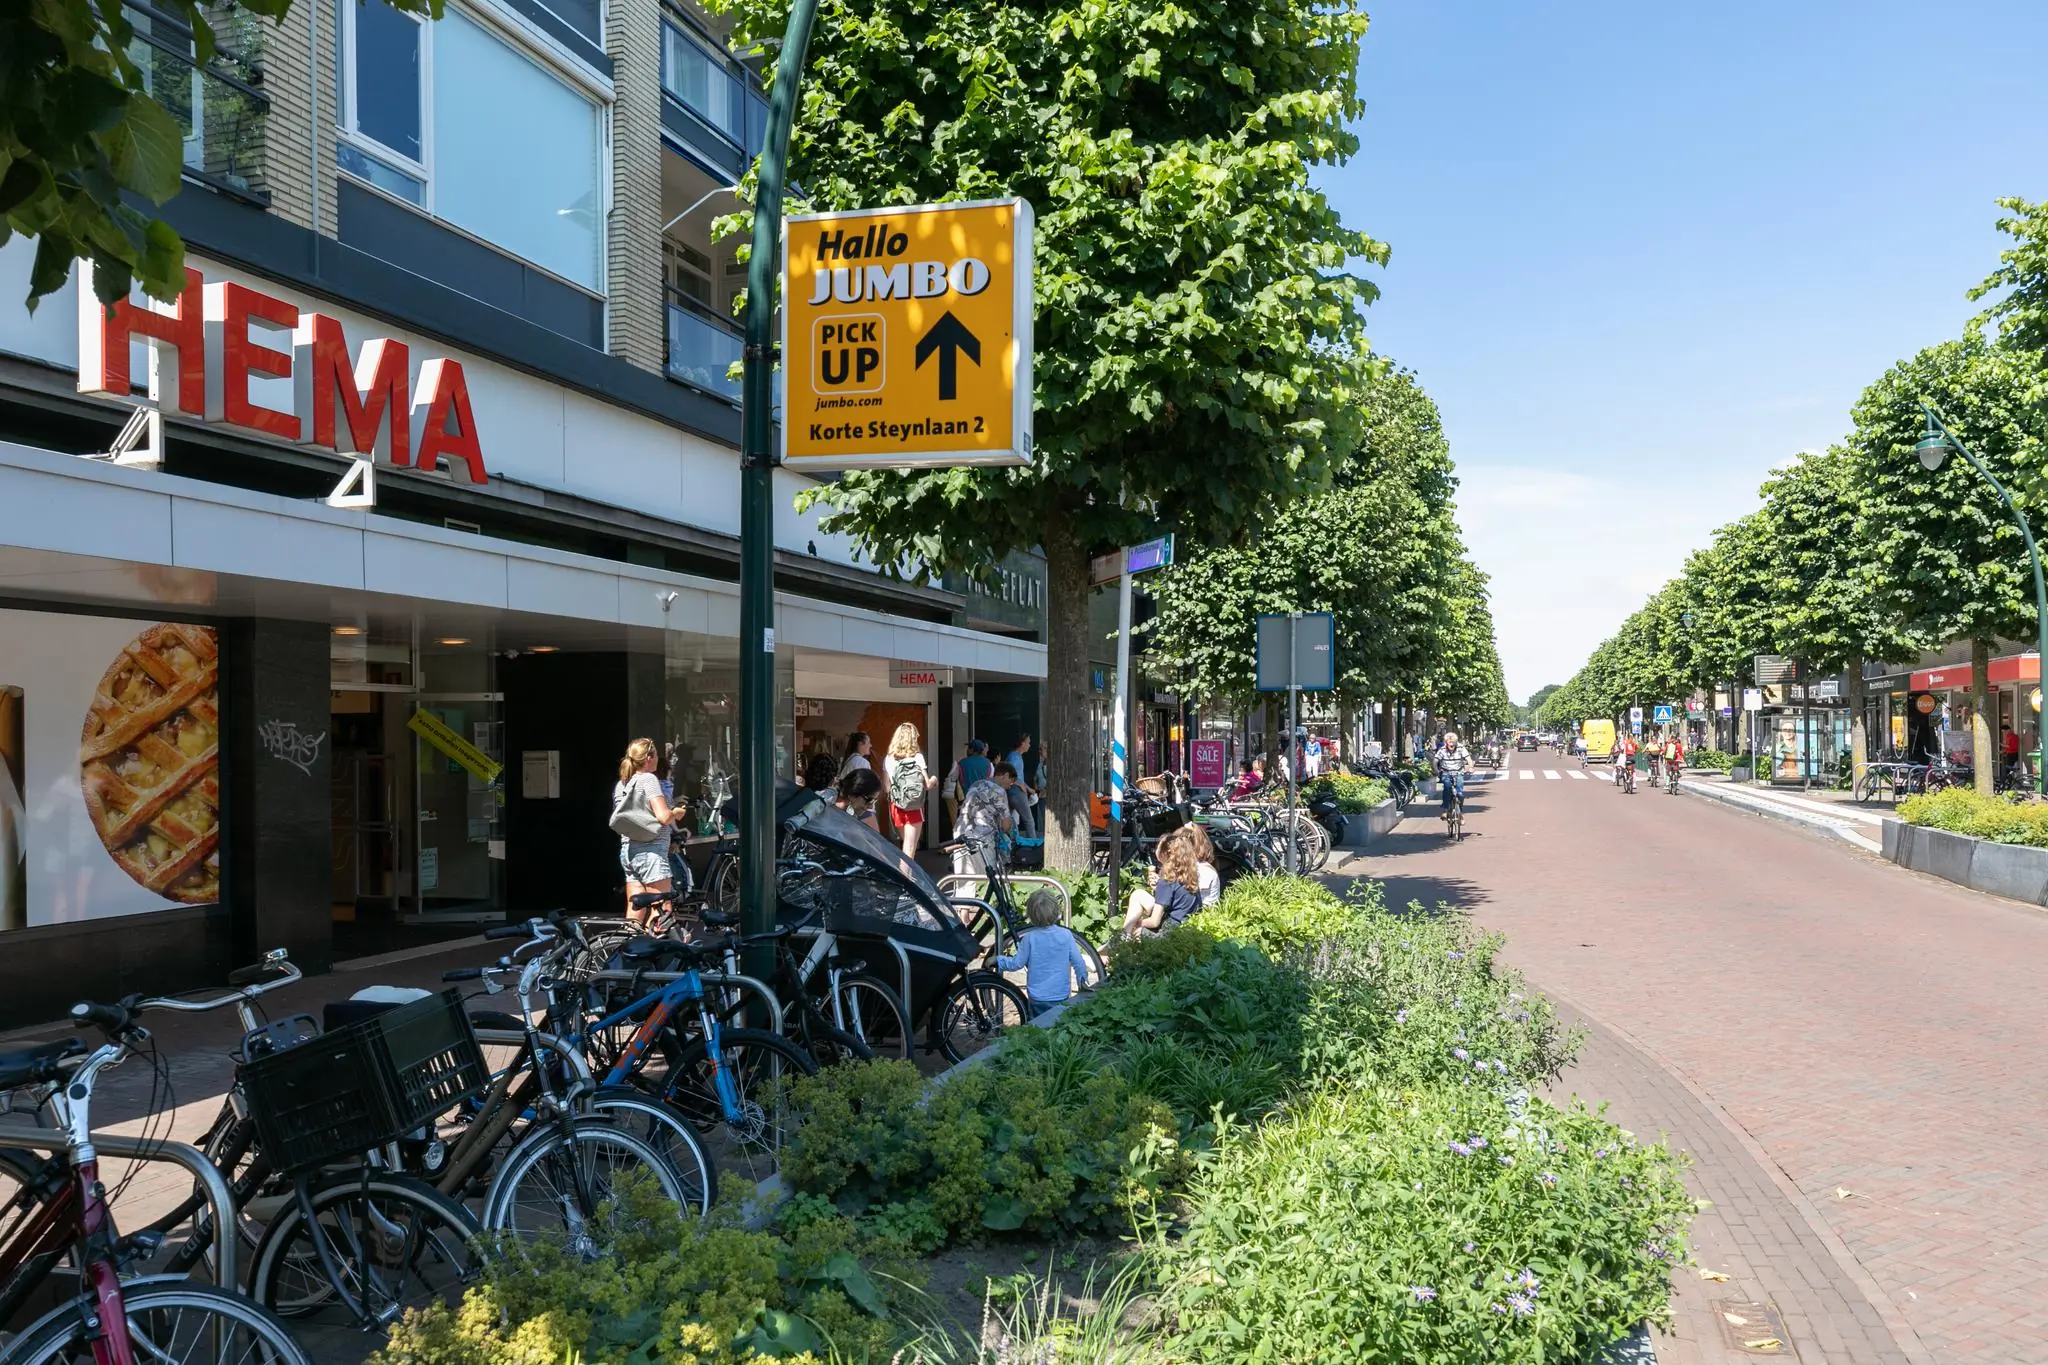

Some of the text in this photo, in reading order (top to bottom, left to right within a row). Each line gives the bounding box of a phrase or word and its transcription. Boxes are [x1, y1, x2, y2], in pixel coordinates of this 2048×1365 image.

[816, 224, 909, 261] Hallo
[808, 258, 991, 305] JUMBO
[822, 322, 877, 344] PICK
[101, 259, 488, 486] HEMA
[822, 348, 879, 385] UP
[815, 396, 883, 412] jumbo.com
[809, 416, 984, 442] Korte Steynlaan 2
[900, 671, 937, 685] HEMA
[1196, 749, 1219, 762] SALE
